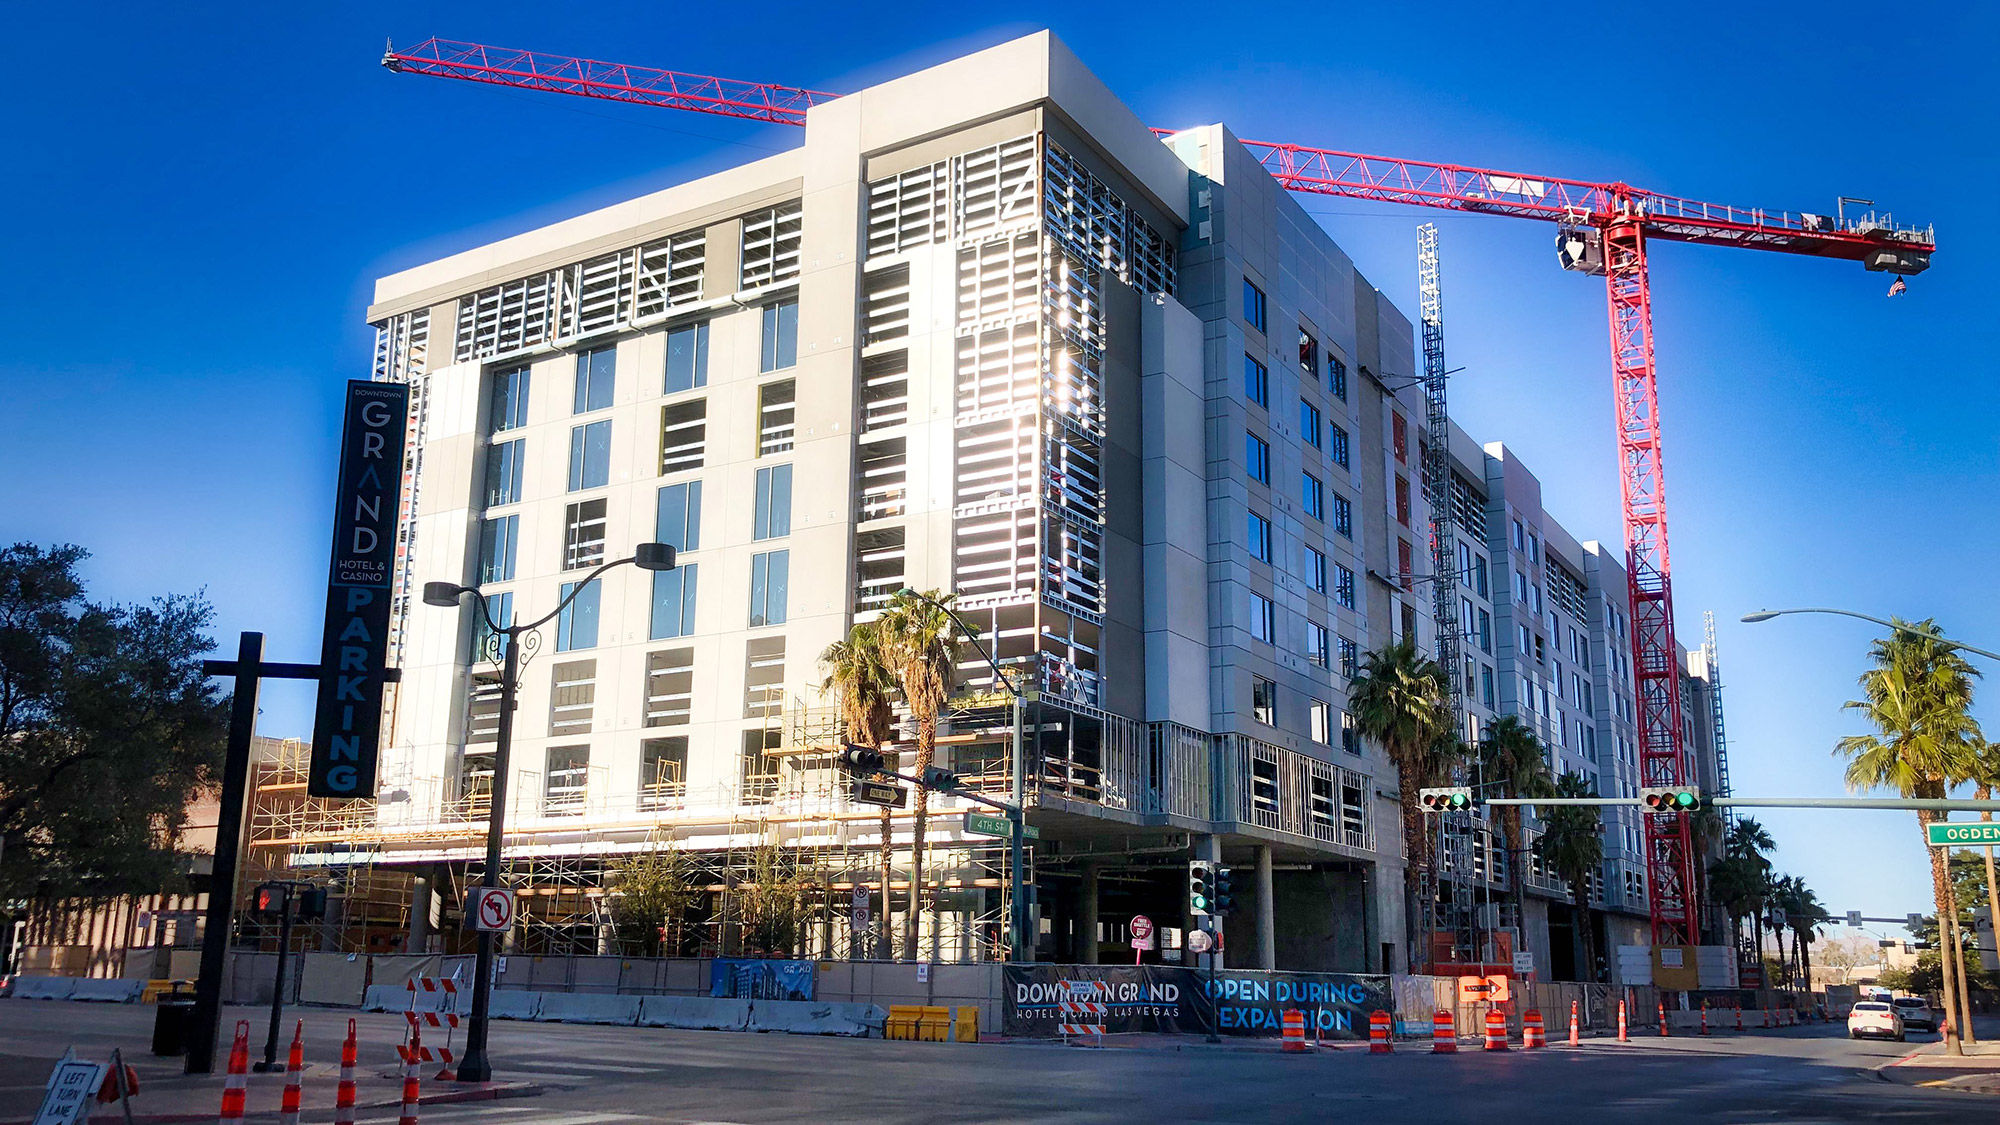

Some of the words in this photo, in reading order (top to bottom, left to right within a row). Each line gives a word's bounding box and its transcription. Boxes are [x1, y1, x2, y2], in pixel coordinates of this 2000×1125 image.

[355, 389, 401, 398] DOWNTOWN
[352, 401, 391, 554] GRAND
[339, 559, 375, 570] HOTEL
[377, 561, 385, 571] &
[341, 571, 382, 582] CASINO
[326, 588, 373, 792] PARKING
[871, 789, 881, 797] ONE
[881, 791, 892, 799] WAY
[977, 819, 993, 830] 4TH
[995, 821, 1004, 831] ST
[1947, 828, 2000, 839] OGDEN
[784, 965, 810, 974] GRND
[1119, 983, 1179, 1002] GRAND
[1205, 979, 1270, 1000] OPEN
[1276, 981, 1365, 1004] DURING
[1017, 1009, 1054, 1019] HOTEL
[1115, 1007, 1132, 1017] LAS
[1137, 1006, 1179, 1017] VEGAS
[1219, 1007, 1352, 1031] EXPASION
[63, 1073, 87, 1085] LEFT
[57, 1088, 81, 1101] TURN
[48, 1104, 73, 1117] LANE
